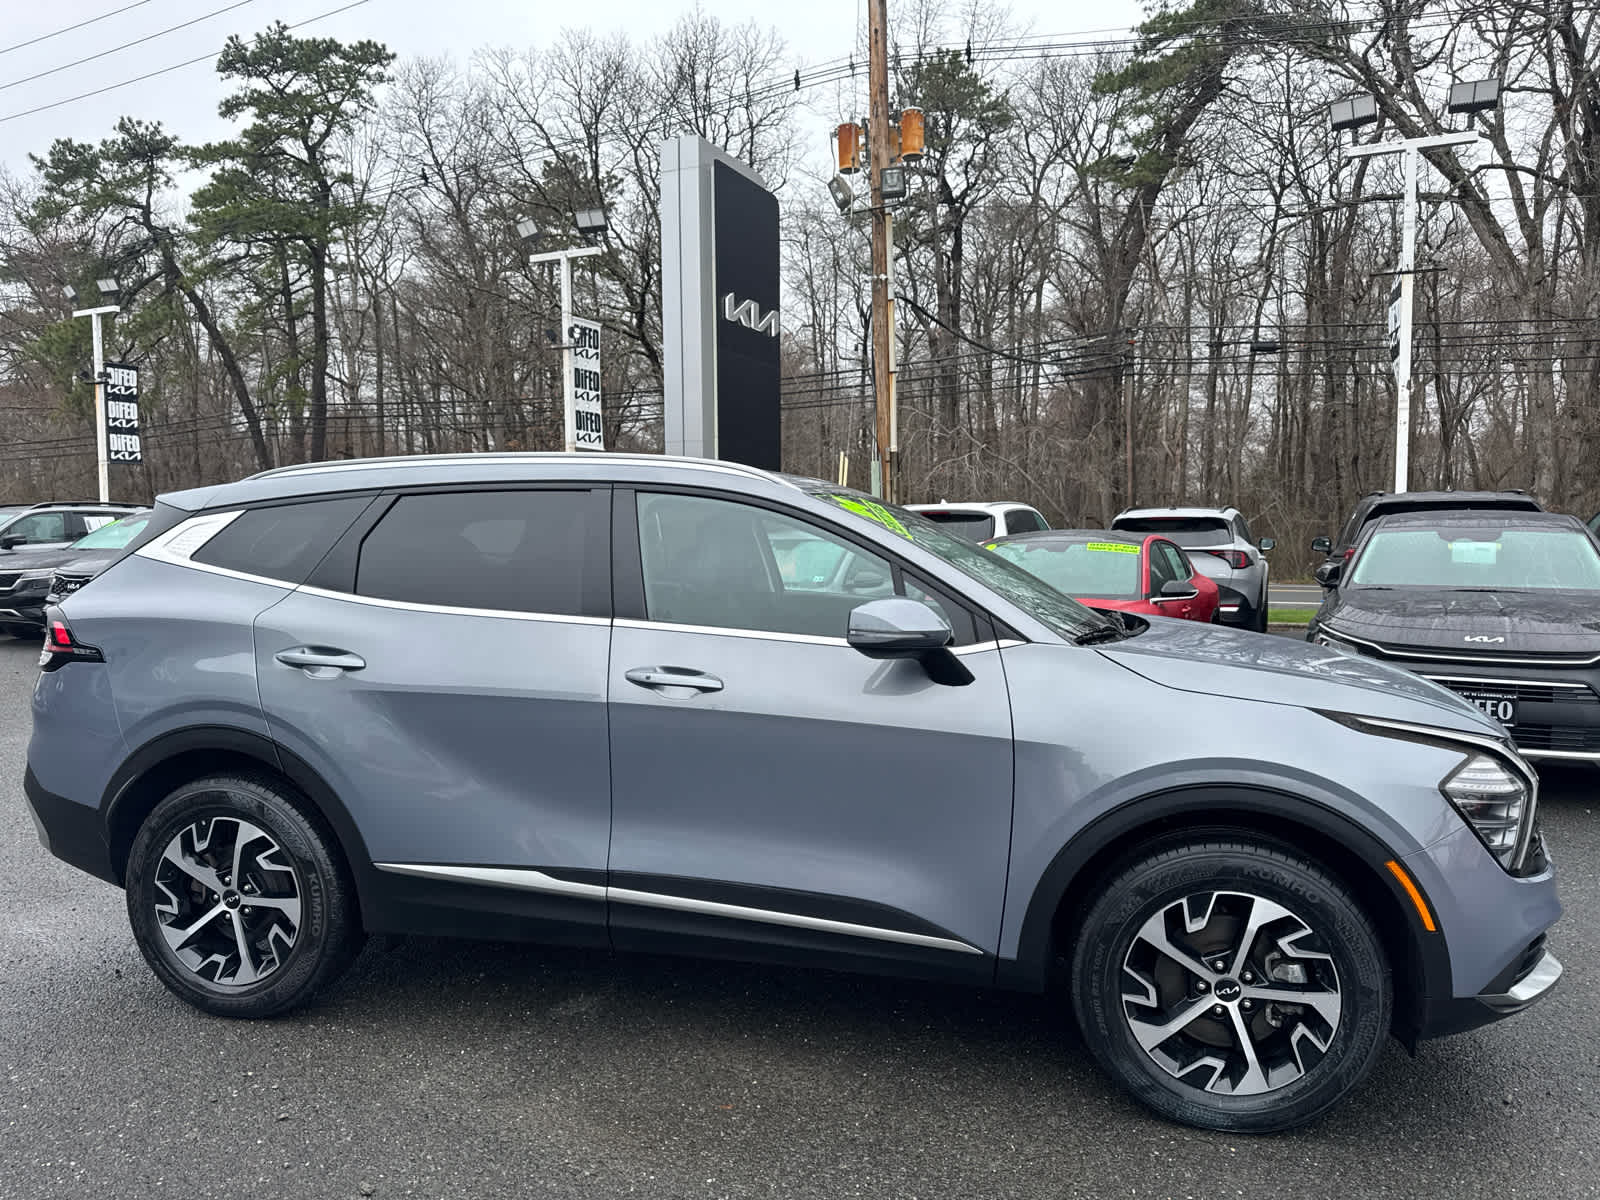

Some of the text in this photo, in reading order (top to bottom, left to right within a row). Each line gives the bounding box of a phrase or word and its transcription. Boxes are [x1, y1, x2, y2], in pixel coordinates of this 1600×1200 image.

[725, 292, 780, 337] KIA
[1463, 635, 1505, 643] KIA
[308, 872, 321, 937] KUMHO
